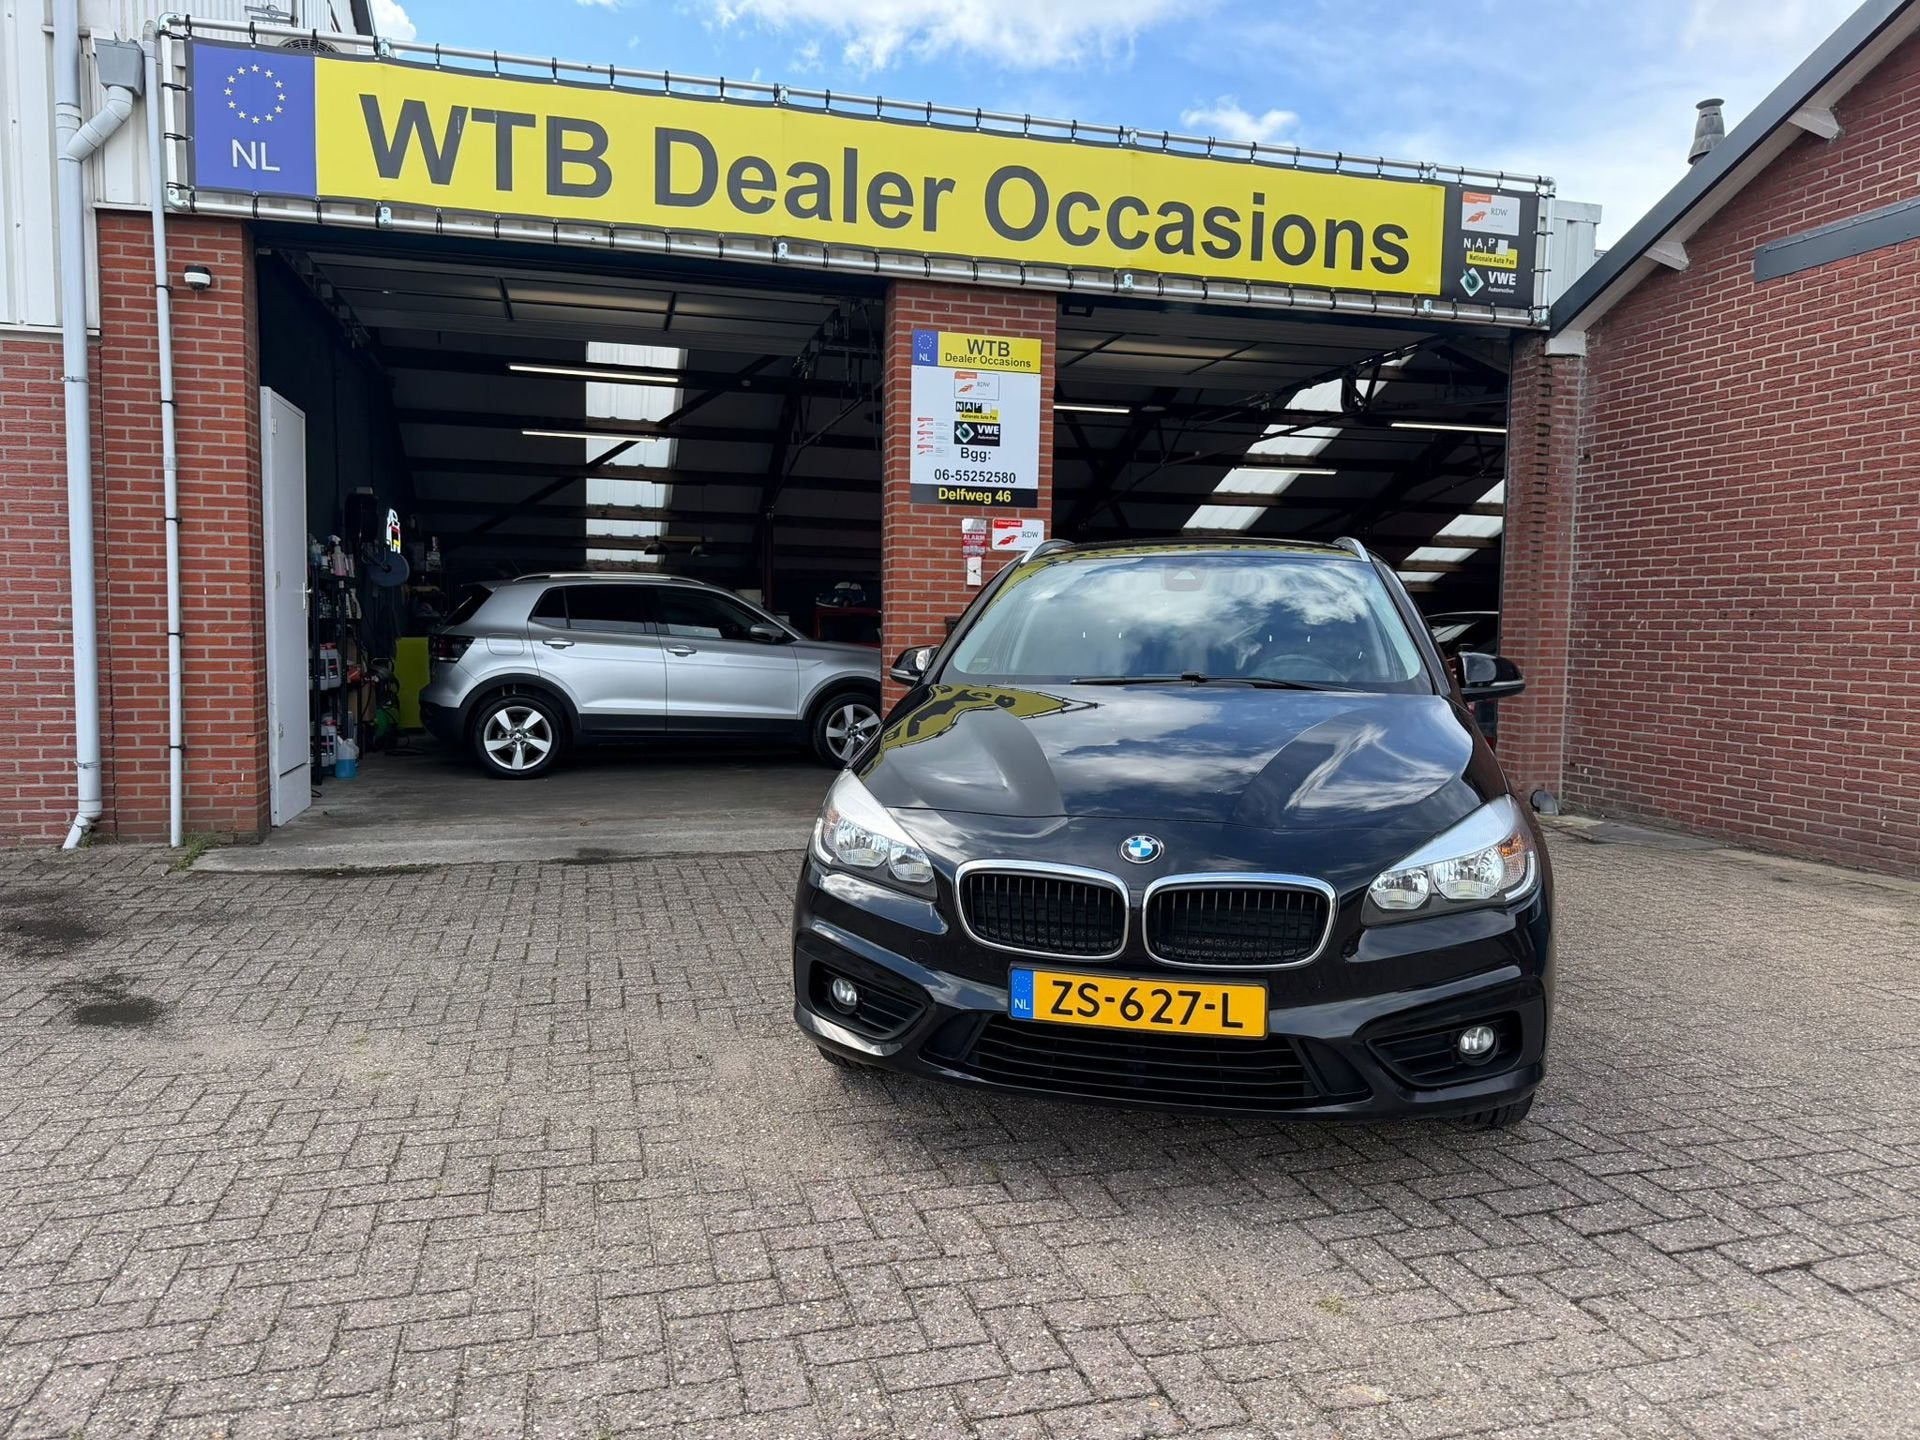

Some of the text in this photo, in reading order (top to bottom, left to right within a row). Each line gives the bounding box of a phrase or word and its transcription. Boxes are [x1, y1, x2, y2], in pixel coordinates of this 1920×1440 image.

[230, 138, 281, 172] NL
[358, 93, 1410, 275] WTB Dealer Occasions
[1490, 207, 1508, 217] RDW
[1488, 270, 1517, 286] VWE
[967, 338, 1011, 357] WTB
[919, 352, 931, 362] NL
[945, 352, 1032, 368] Dealer Occasions
[977, 424, 1000, 435] VWE
[960, 447, 992, 462] Bgg:
[934, 468, 1017, 484] 06-55252580
[938, 487, 1012, 504] Delfweg 46
[1021, 530, 1039, 538] RDW
[1014, 999, 1031, 1010] NL
[1050, 980, 1244, 1029] ZS-627-L
